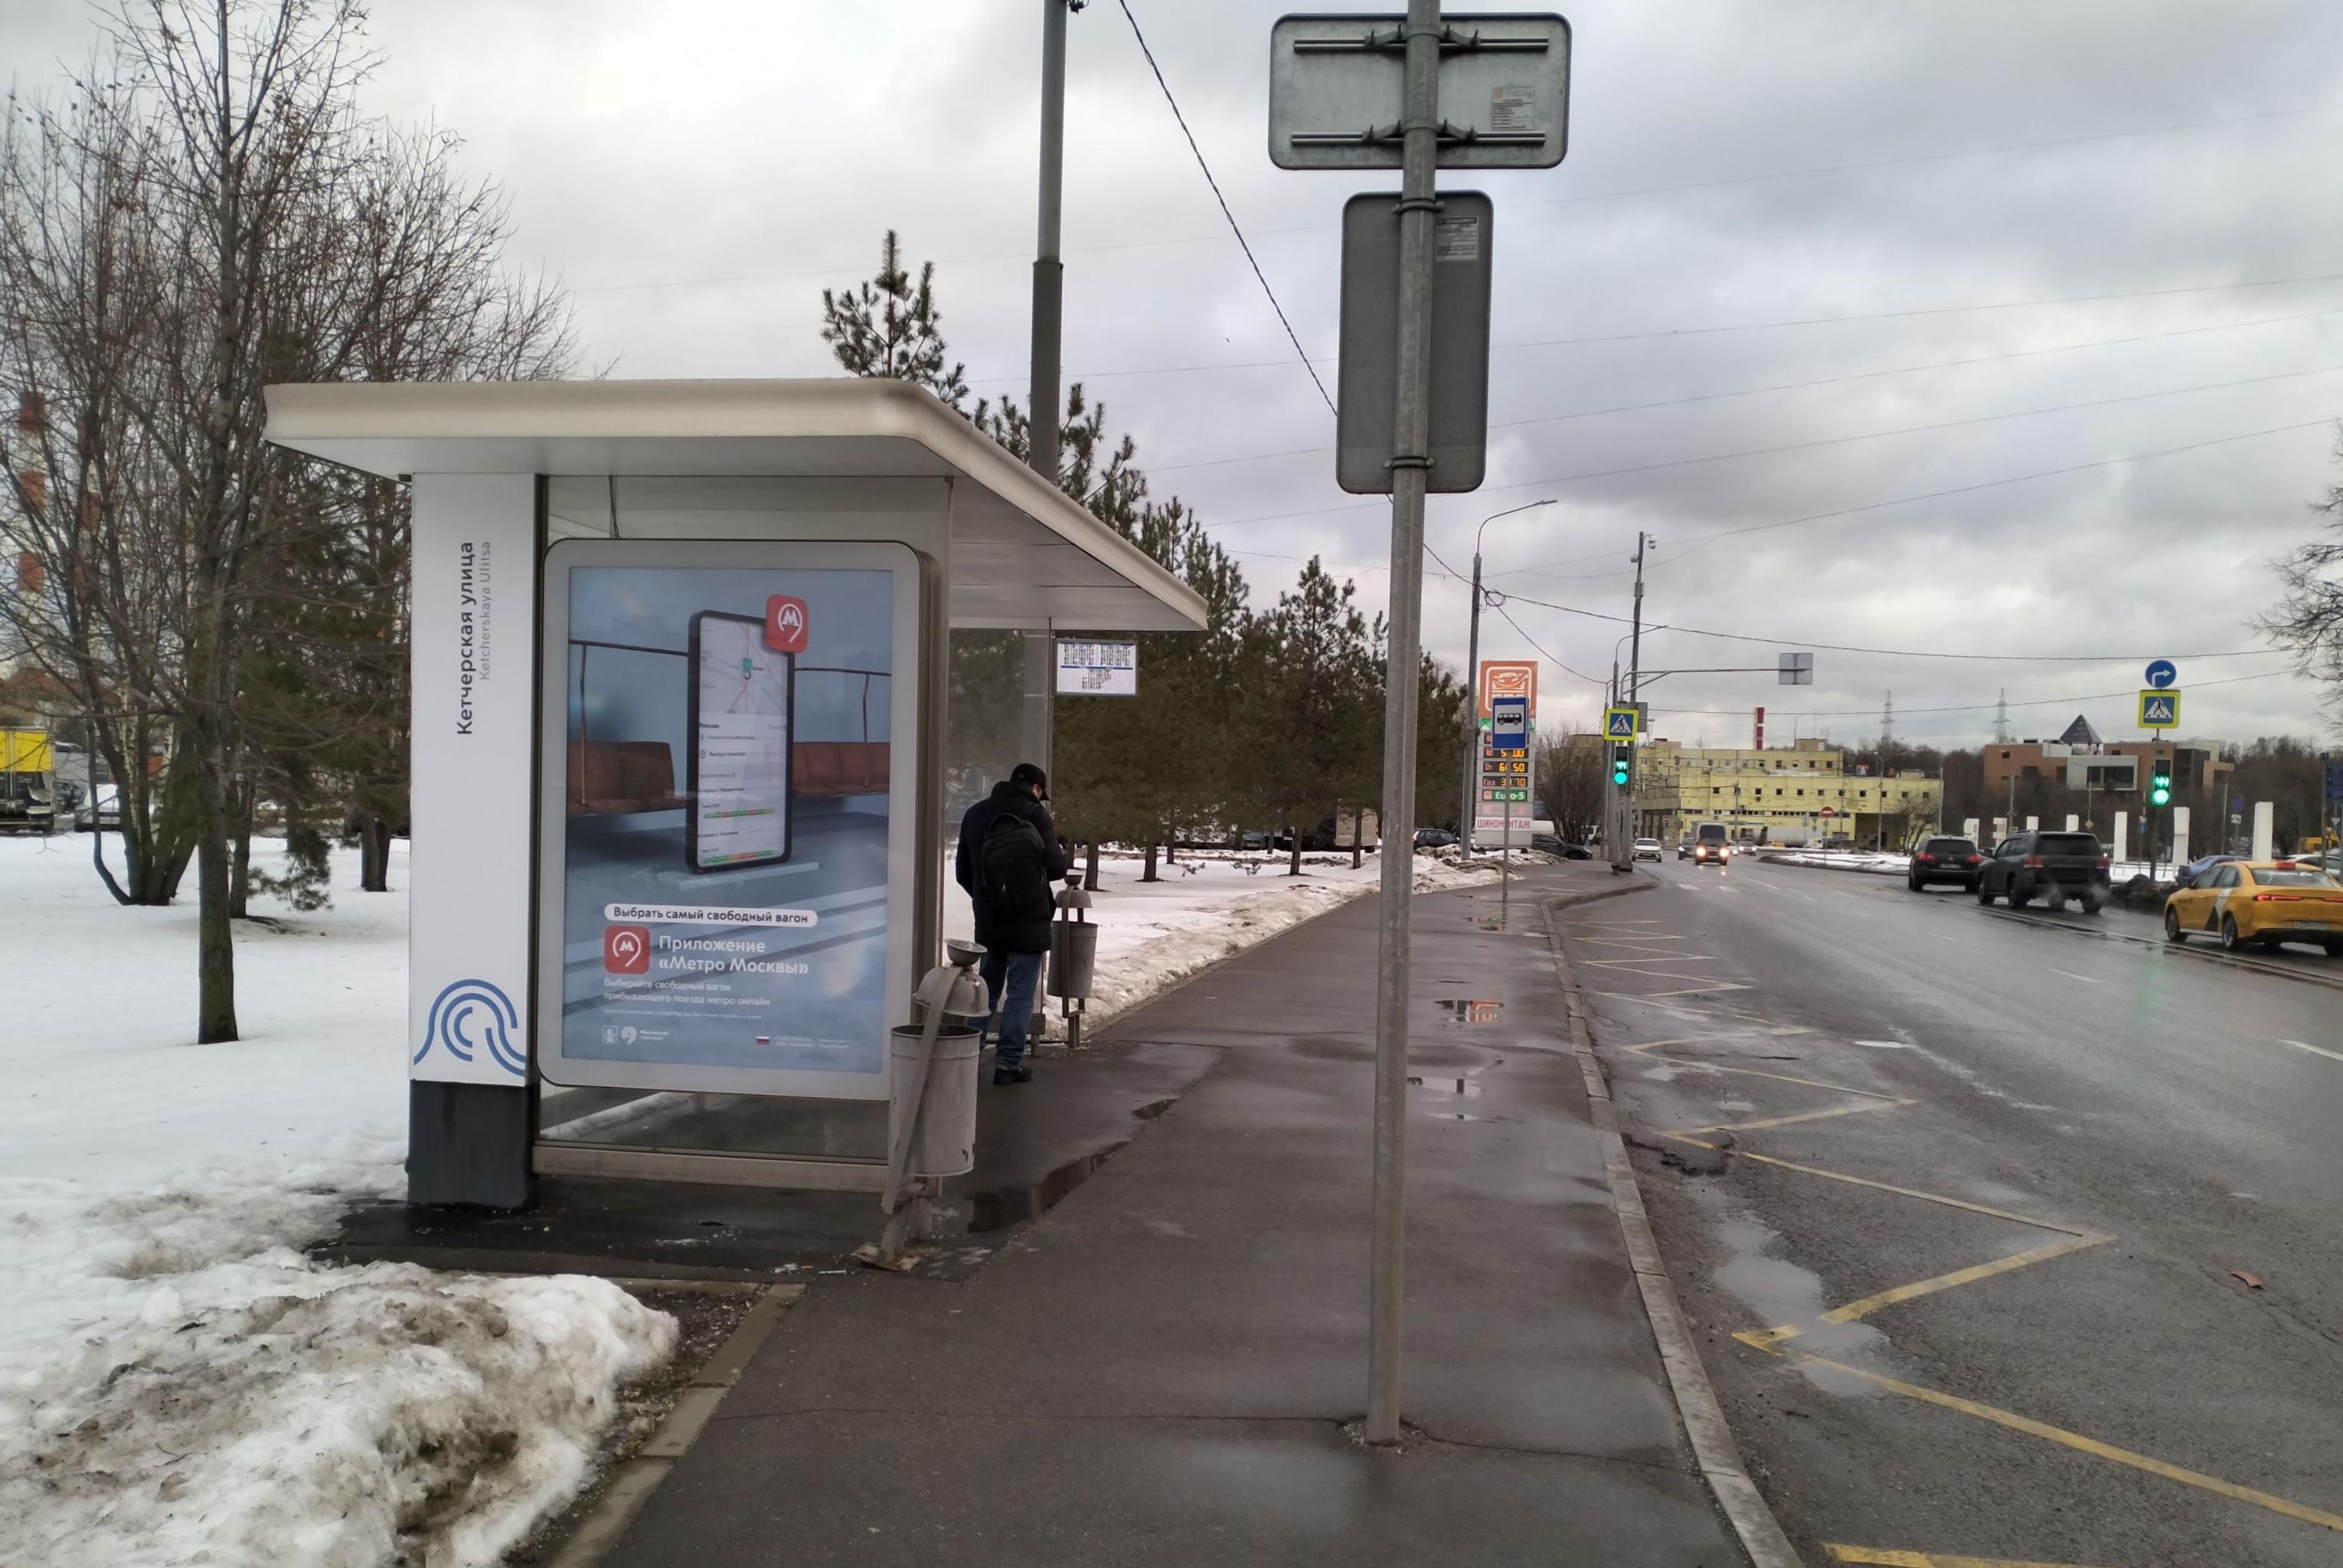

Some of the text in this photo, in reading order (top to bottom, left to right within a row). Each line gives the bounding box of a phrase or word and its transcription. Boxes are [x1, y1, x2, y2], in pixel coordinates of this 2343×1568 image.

[479, 542, 492, 680] Ketcherskaya Ulitsa
[457, 543, 476, 734] Кетчерская улица
[1495, 792, 1524, 800] Euo-5
[1478, 818, 1530, 829] ШИНОМНТАЖ
[614, 906, 808, 923] Выбрать самый свободный вагон
[659, 935, 766, 952] Приложение
[658, 956, 809, 974] «Метро Москвы»
[604, 978, 652, 988] Выбирайте
[655, 981, 704, 990] свободный
[674, 995, 704, 1004] поезда
[707, 997, 735, 1005] метро
[737, 997, 770, 1005] онлайн
